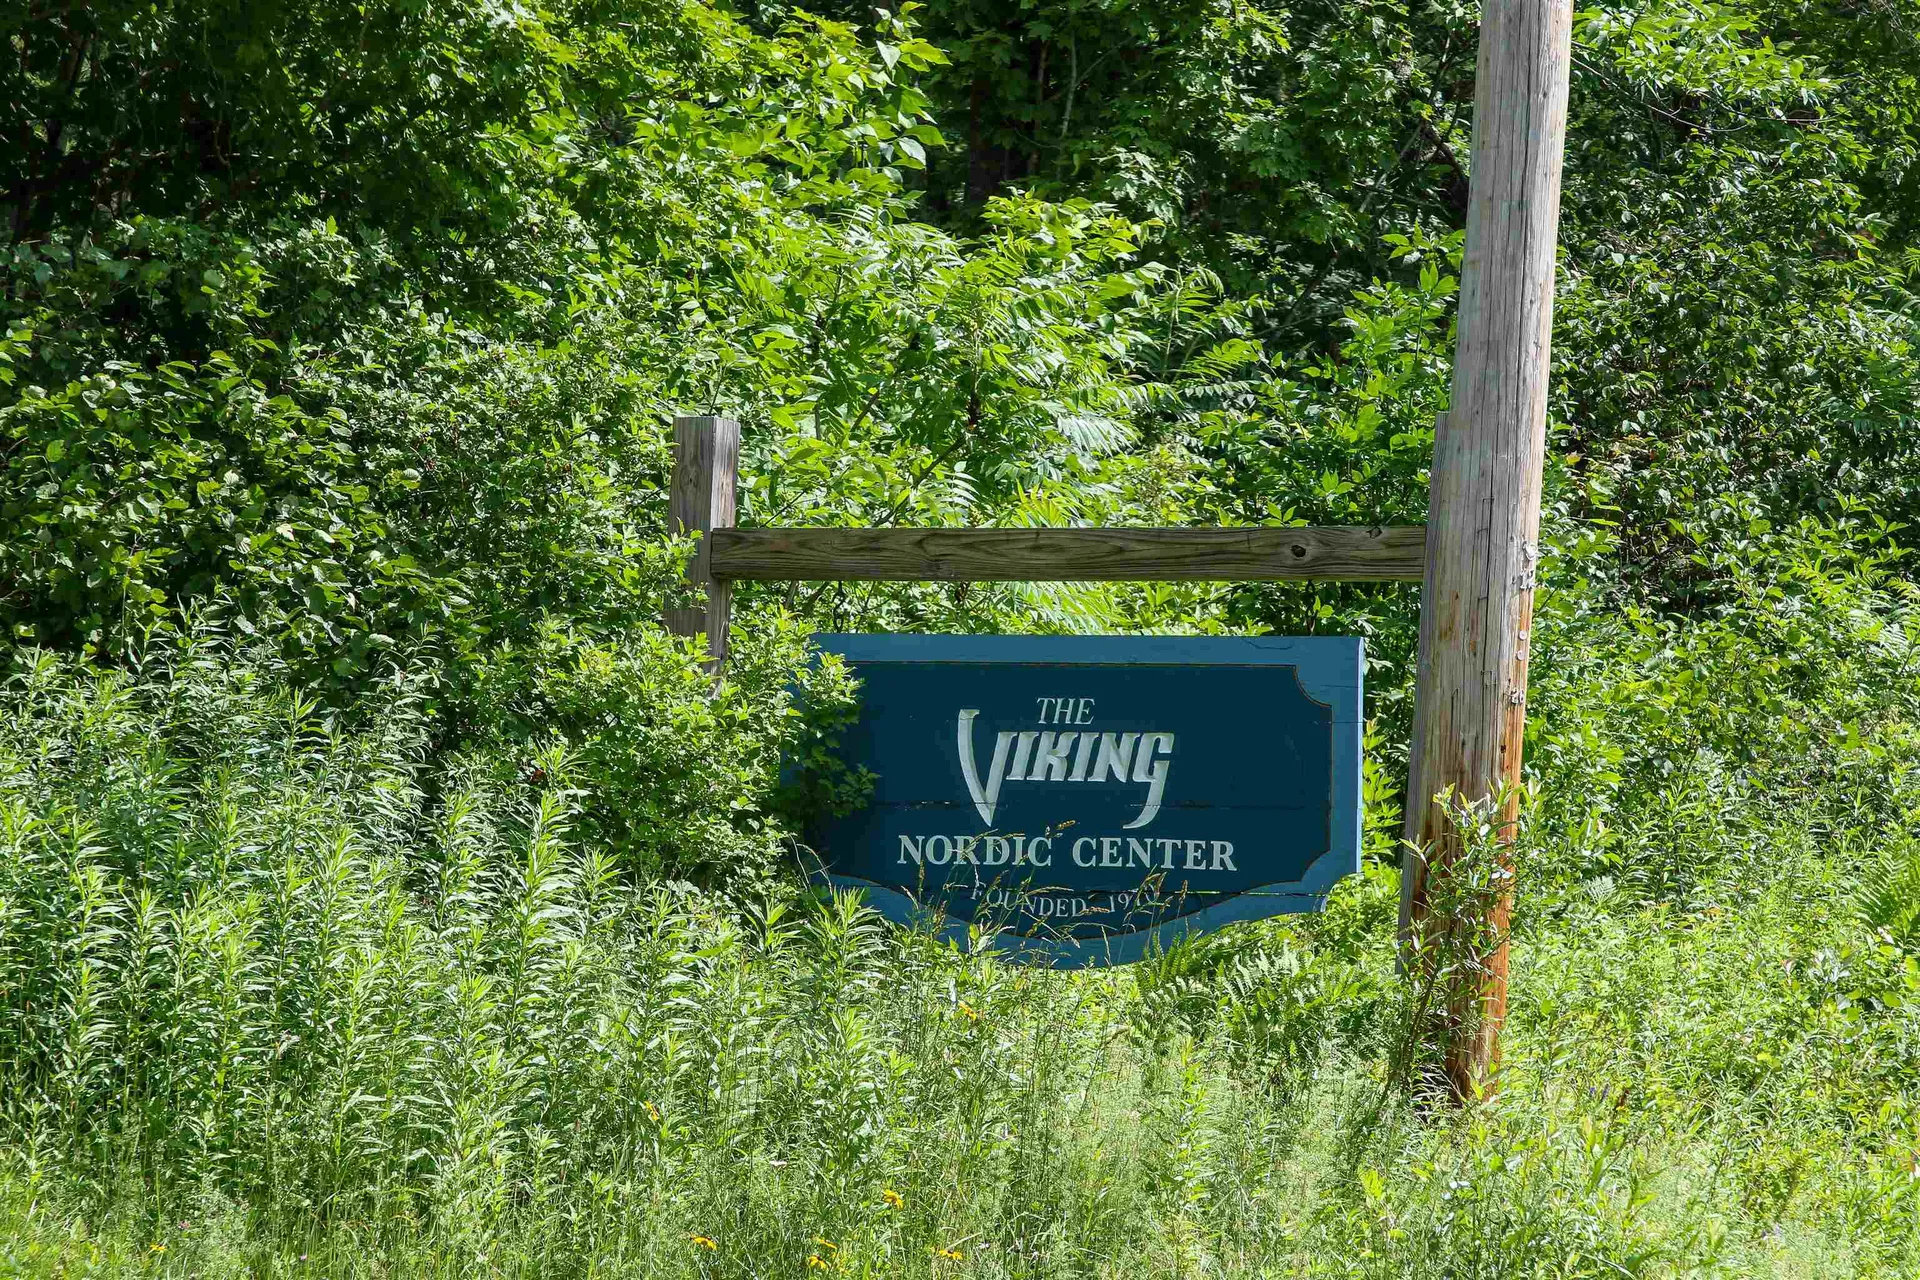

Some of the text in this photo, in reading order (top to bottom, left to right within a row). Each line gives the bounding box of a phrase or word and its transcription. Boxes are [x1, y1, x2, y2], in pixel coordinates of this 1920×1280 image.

[1037, 697, 1095, 725] THE
[957, 709, 1175, 829] VIKING
[897, 834, 1237, 871] NORDIC CENTER
[970, 882, 1087, 918] FOUNDED
